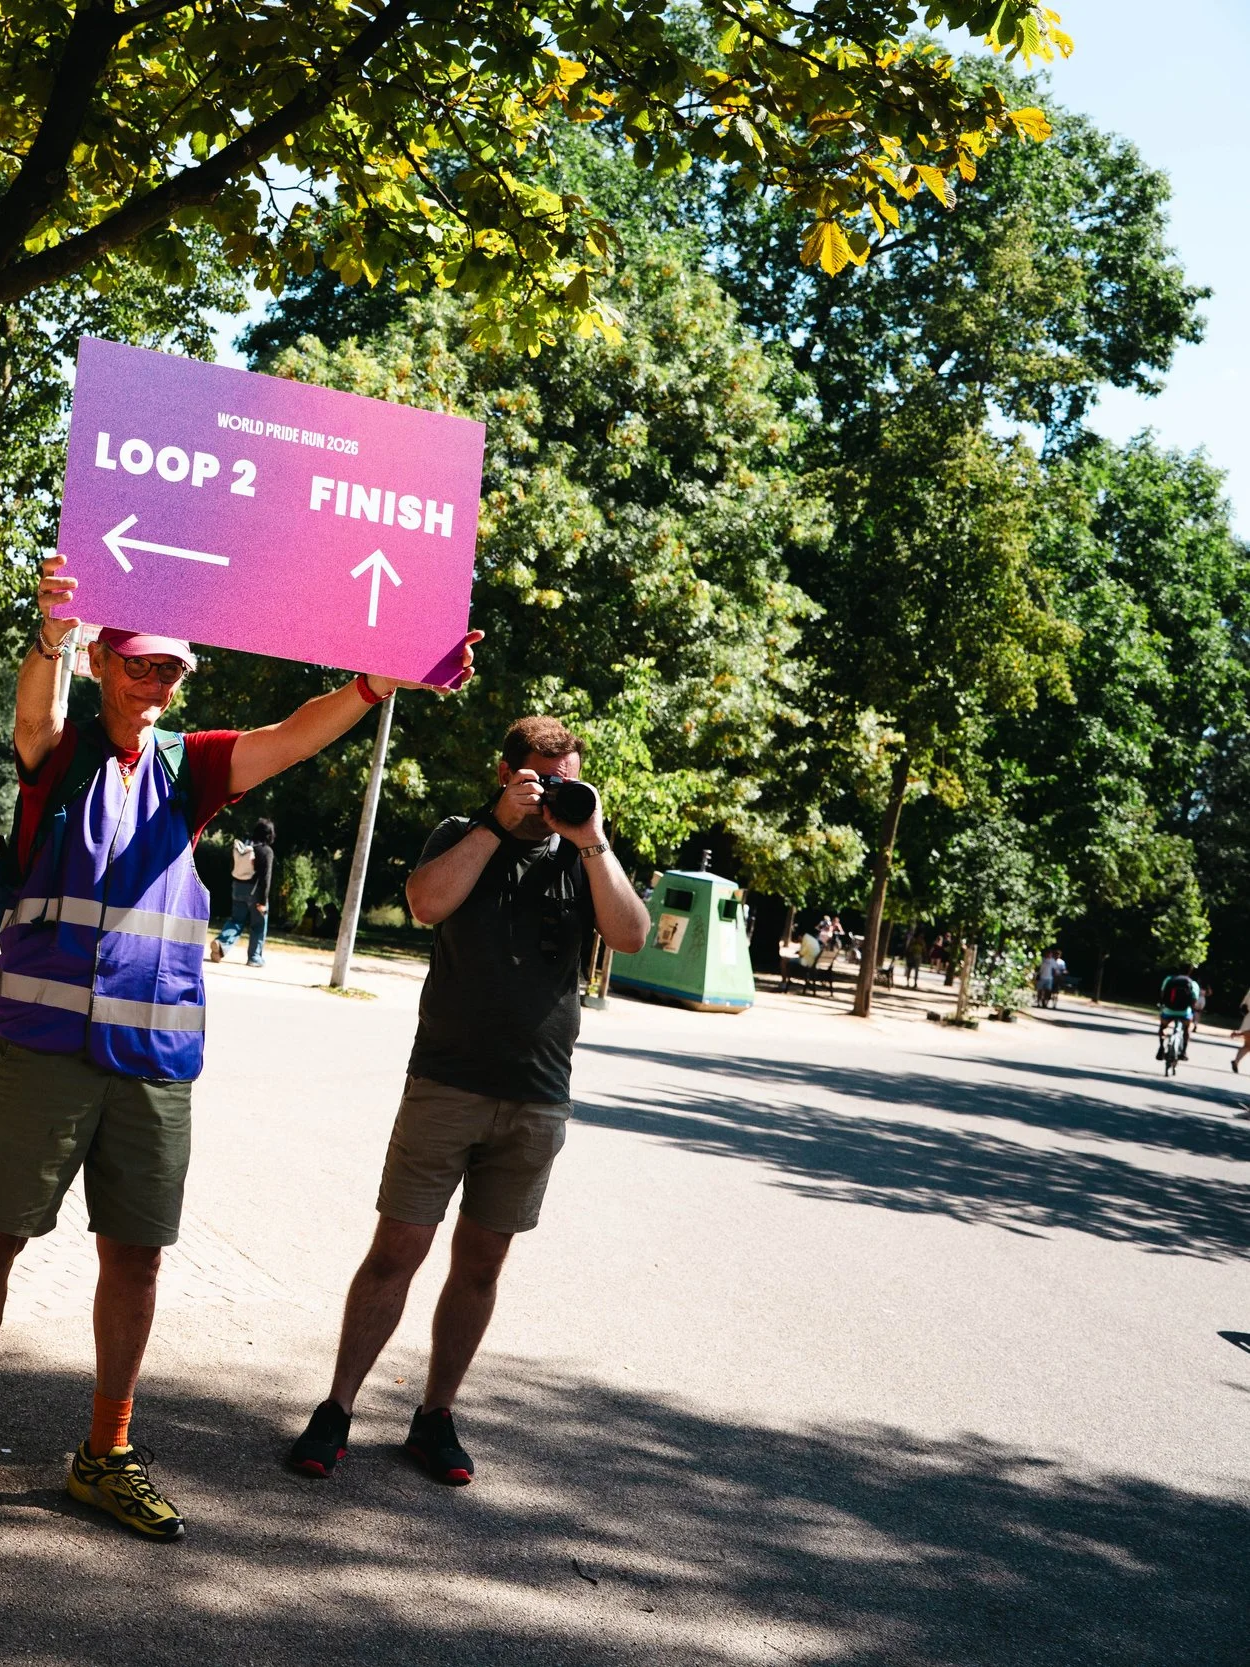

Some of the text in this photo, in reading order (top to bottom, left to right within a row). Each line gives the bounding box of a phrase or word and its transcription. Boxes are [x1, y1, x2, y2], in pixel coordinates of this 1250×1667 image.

[95, 431, 257, 497] LOOP 2
[217, 412, 359, 455] WORLD PRIDE RUN 2026
[309, 475, 454, 538] FINISH
